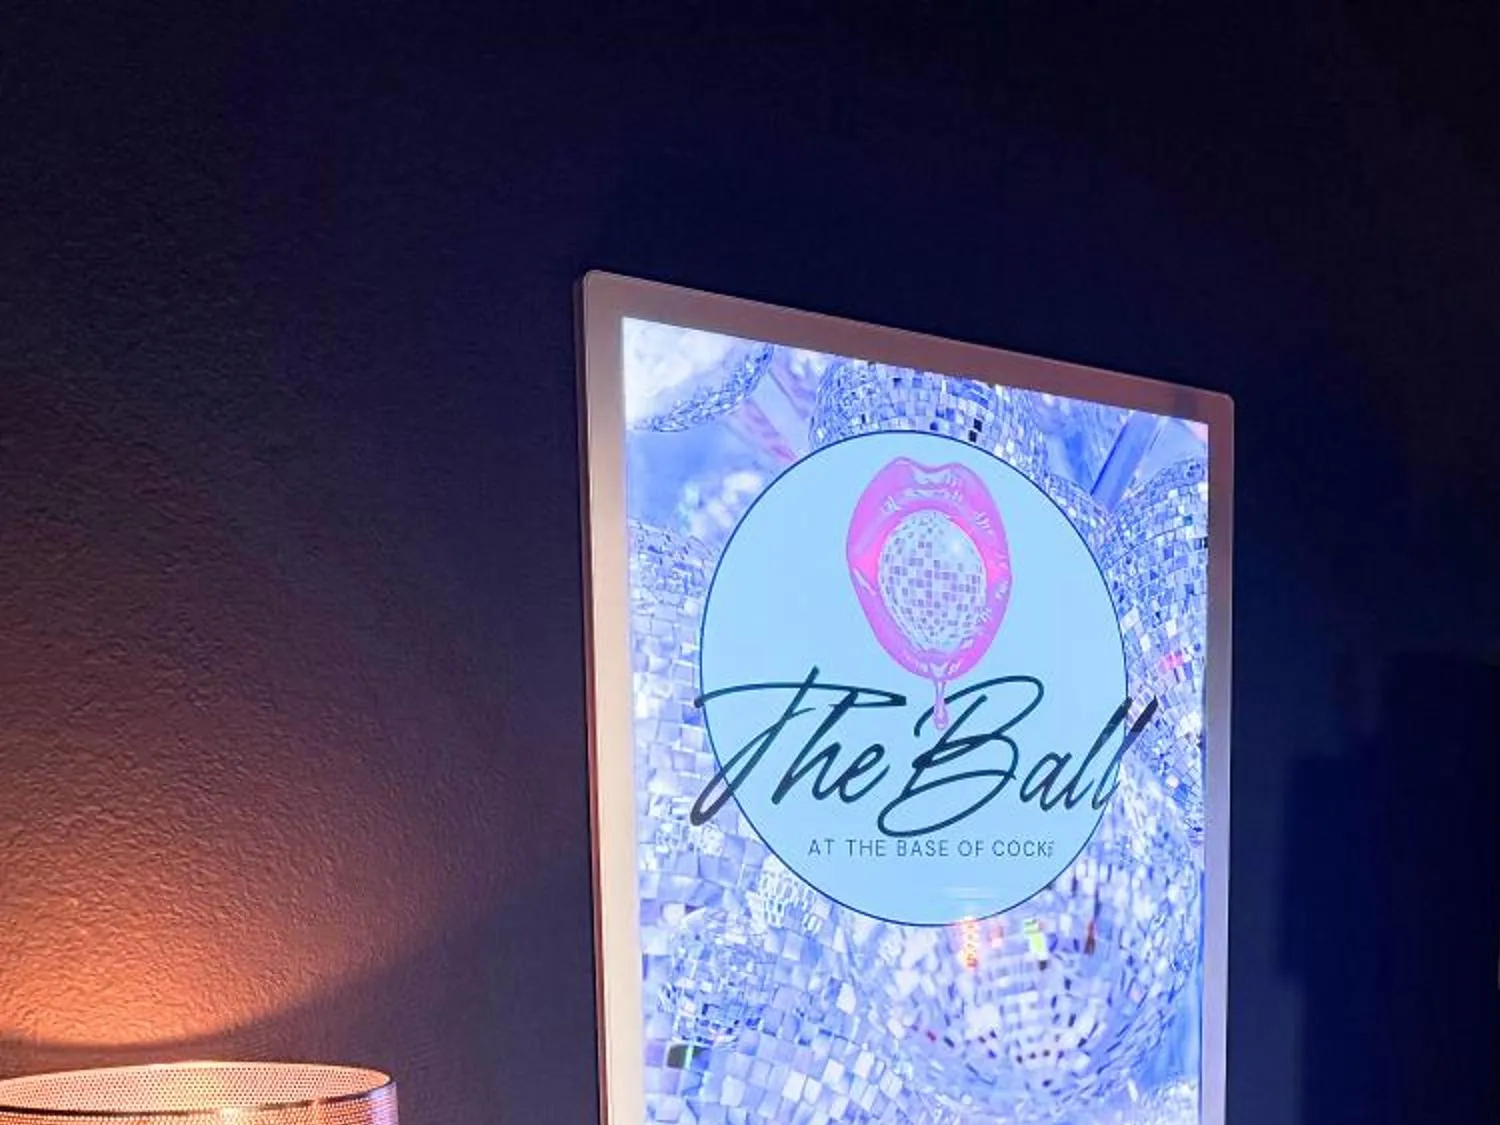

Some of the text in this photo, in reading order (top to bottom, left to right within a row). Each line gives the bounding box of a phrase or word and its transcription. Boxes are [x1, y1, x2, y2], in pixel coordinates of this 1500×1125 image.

[690, 666, 1159, 838] The Ball
[807, 839, 835, 855] AT
[846, 839, 884, 856] THE
[896, 839, 949, 857] BASE
[957, 840, 984, 857] OF
